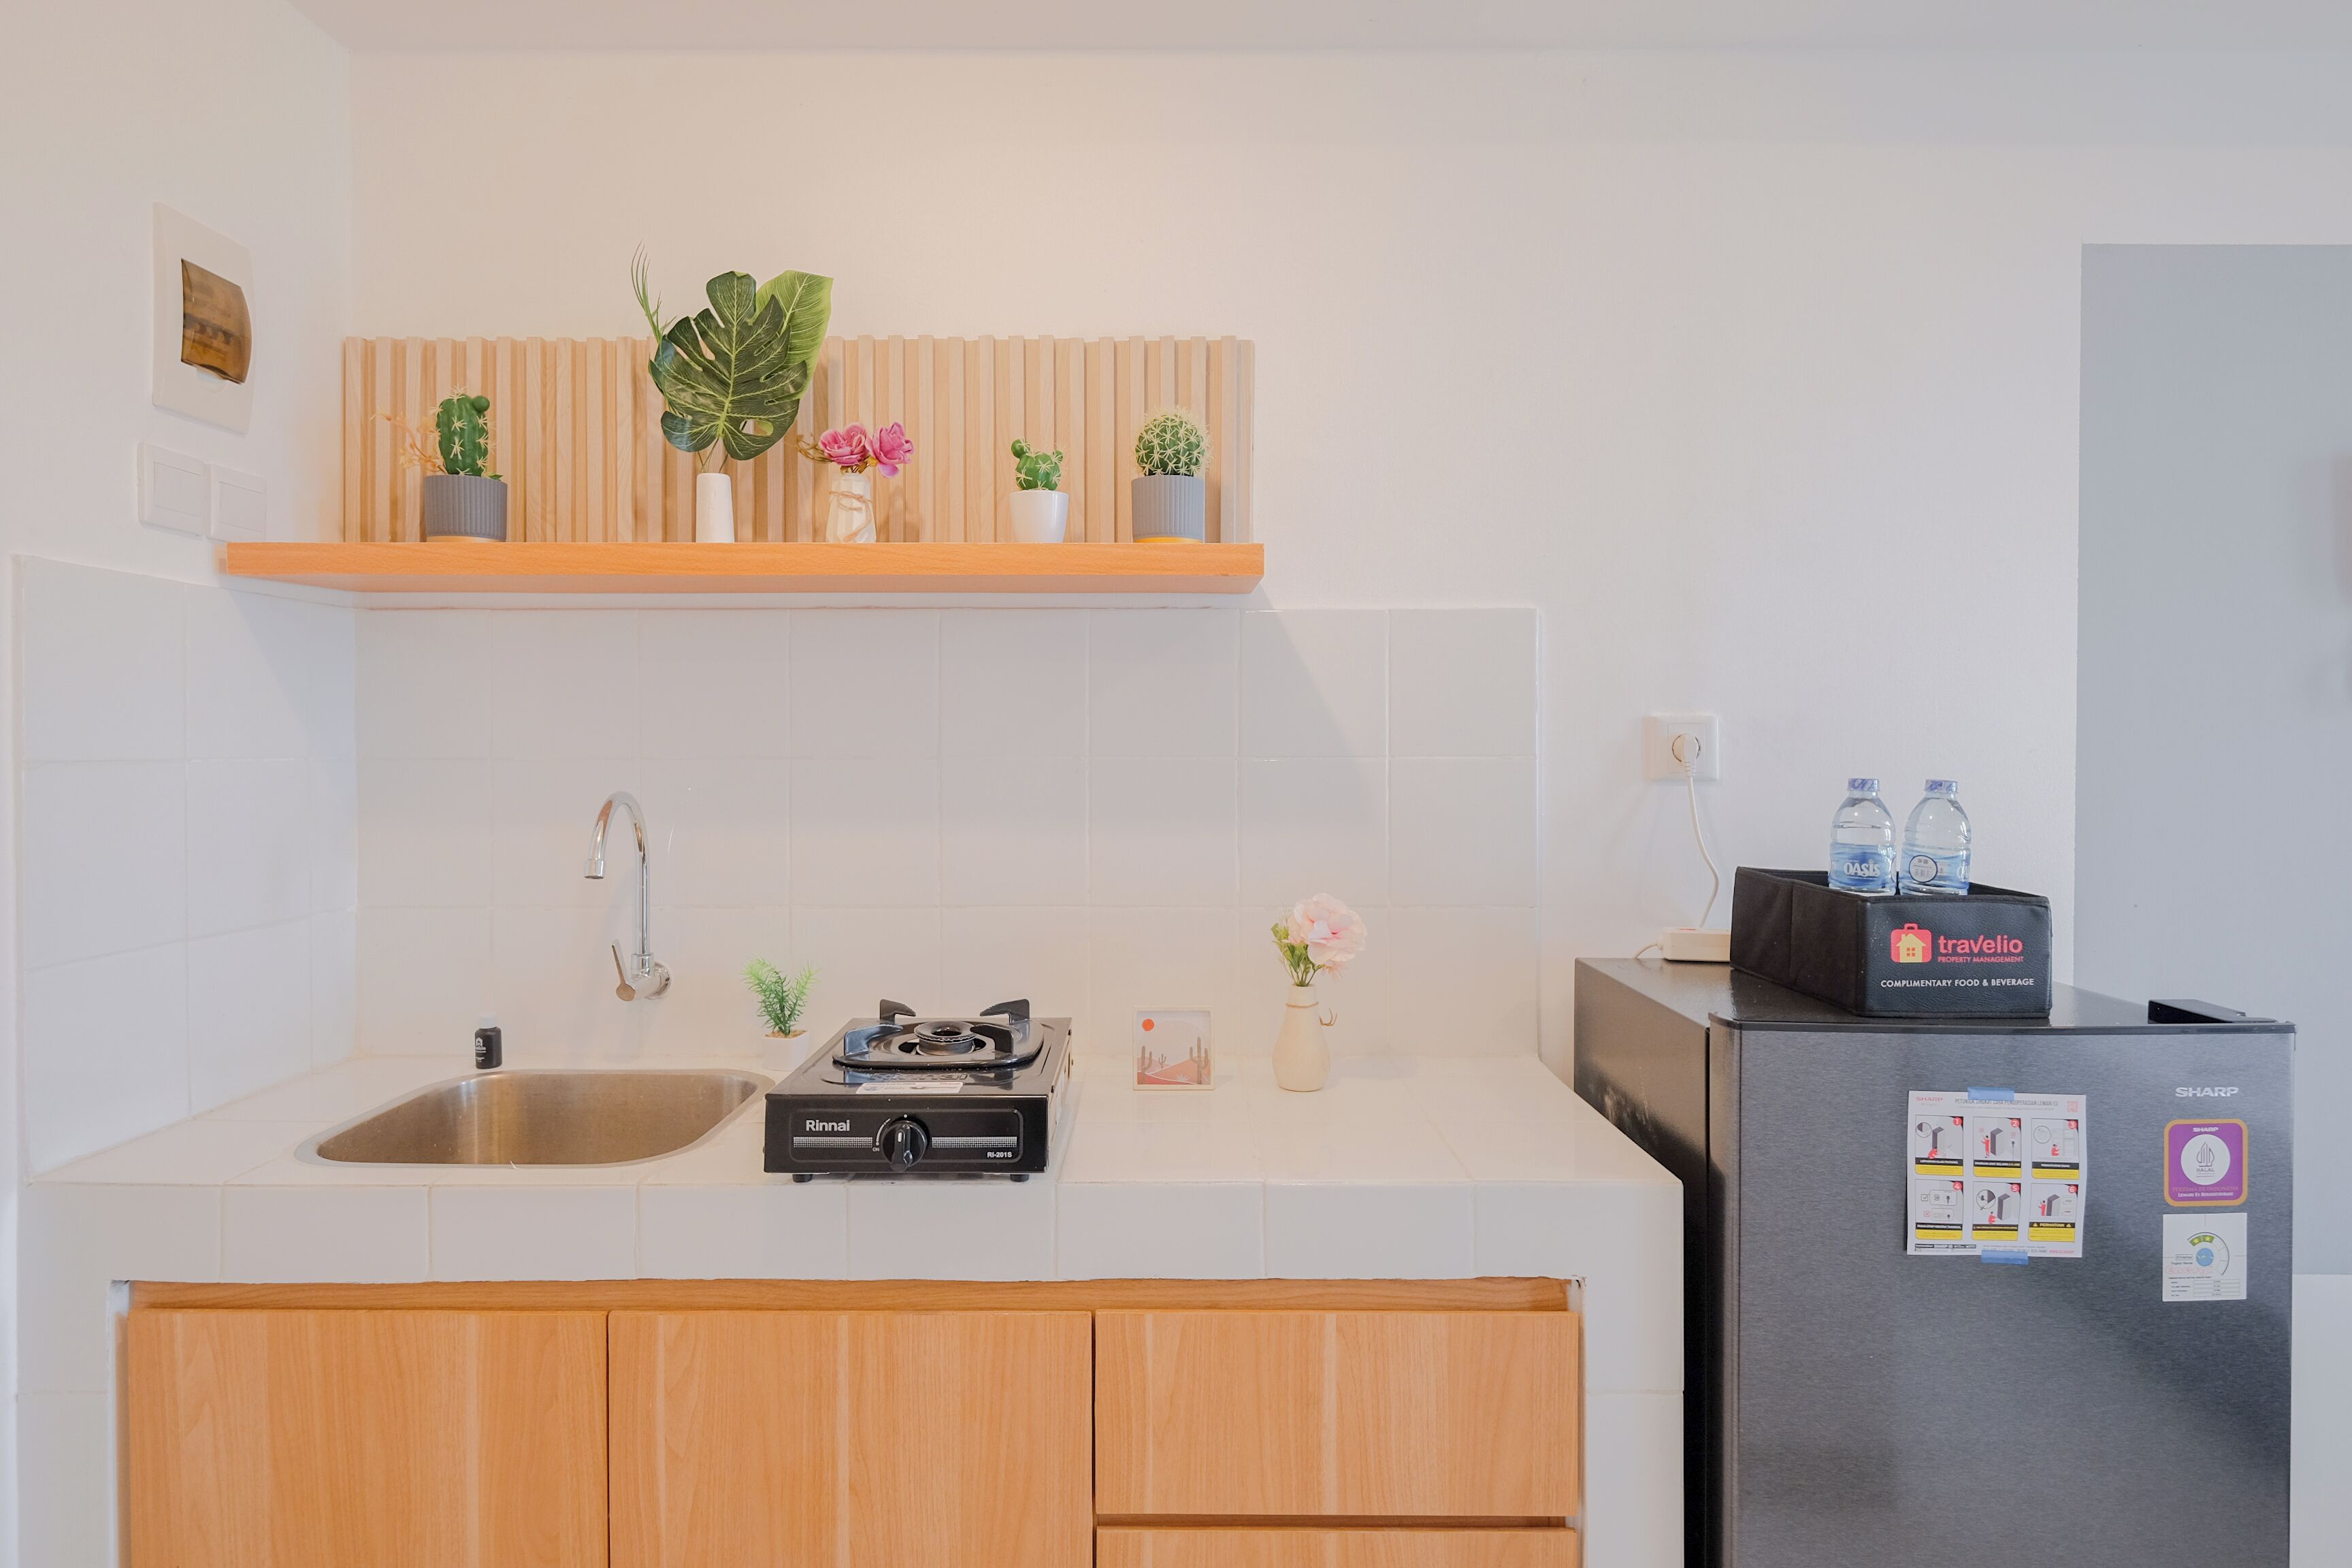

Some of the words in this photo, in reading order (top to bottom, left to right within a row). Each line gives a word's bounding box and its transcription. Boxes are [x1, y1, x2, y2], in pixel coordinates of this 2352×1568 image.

[1880, 979, 1952, 987] COMPLIMENTARY
[1955, 979, 1980, 987] FOOD
[1991, 978, 2034, 986] BEVERAGE
[2175, 1087, 2239, 1097] SHARP
[806, 1120, 850, 1131] Rinnai
